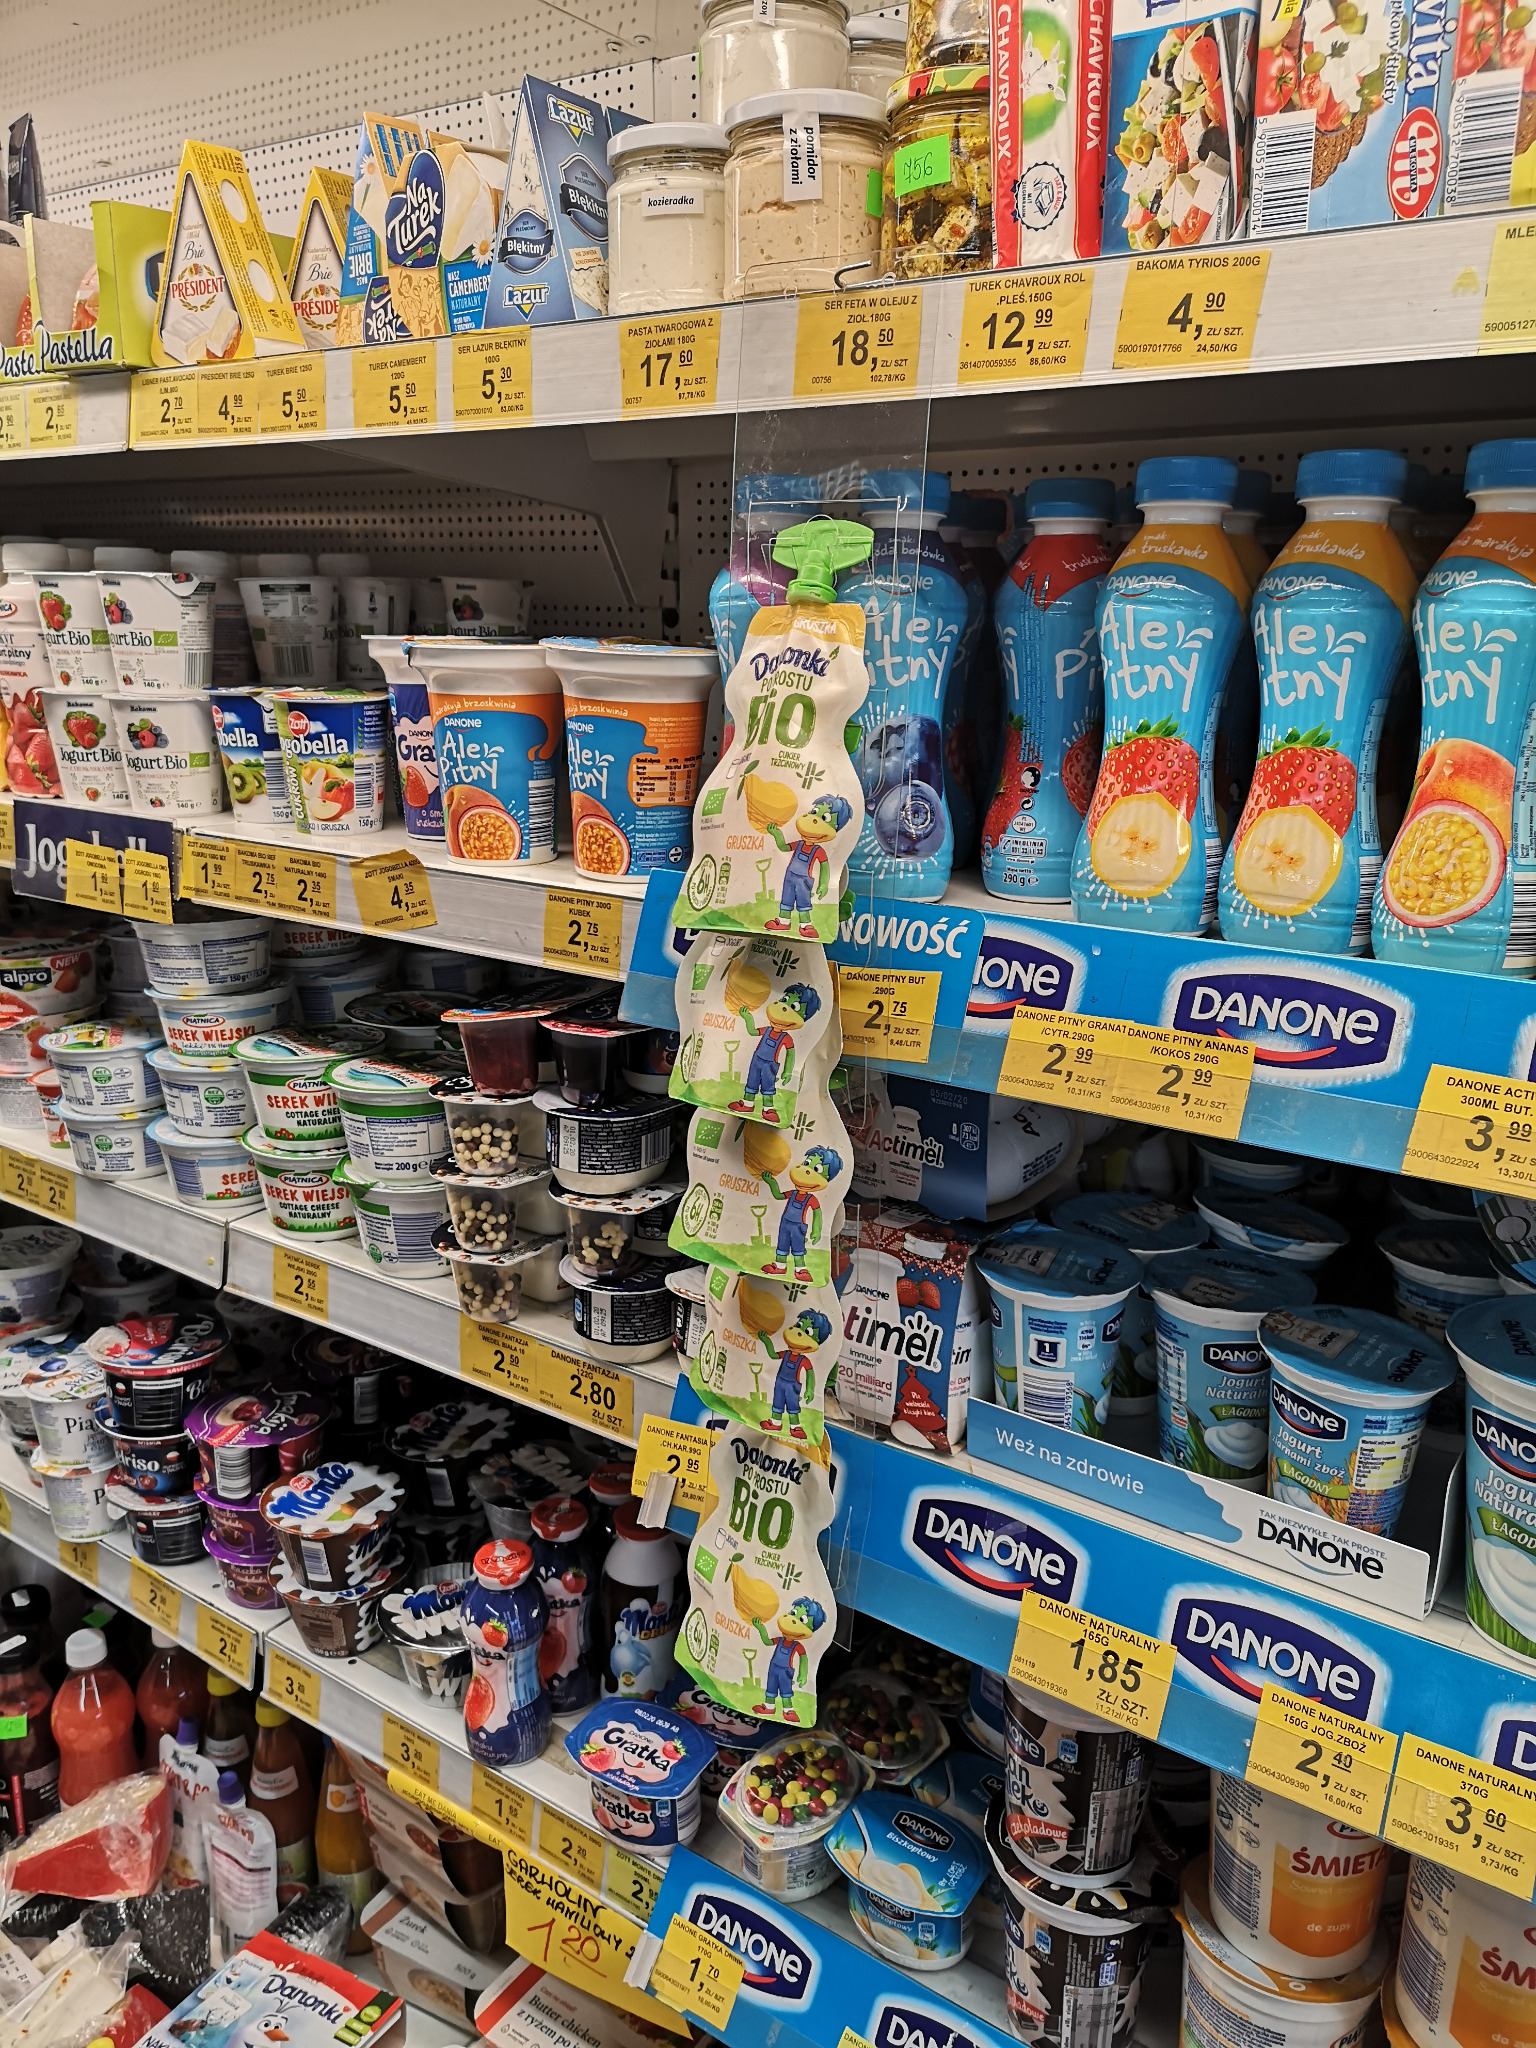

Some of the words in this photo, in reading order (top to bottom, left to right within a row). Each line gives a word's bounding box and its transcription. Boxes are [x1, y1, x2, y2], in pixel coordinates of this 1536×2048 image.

[997, 4, 1012, 161] CHAVROUX
[548, 94, 594, 136] Lazur
[790, 127, 797, 135] z
[790, 137, 802, 186] ziołami
[804, 126, 817, 181] pomidor
[407, 178, 429, 208] Na
[648, 196, 694, 207] kozieradka
[388, 186, 441, 254] Turek
[183, 241, 205, 261] Brie
[507, 239, 545, 256] Błękitny
[307, 263, 333, 281] Brie
[1136, 258, 1184, 271] BAKOMA
[1187, 257, 1228, 269] TYRIOS
[1231, 255, 1261, 267] 200G
[171, 277, 224, 299] PRÉSIDENT
[969, 282, 1002, 292] TUREK
[1004, 277, 1061, 289] CHAVROUX
[1064, 272, 1086, 284] ROL
[504, 285, 550, 308] Lazur
[824, 299, 842, 310] SER
[843, 298, 866, 309] FETA
[868, 298, 878, 307] W
[880, 296, 909, 307] OLEJU
[910, 295, 917, 304] Z
[1205, 292, 1226, 308] 90
[847, 311, 891, 323] ZIOŁ.180G
[1035, 308, 1052, 324] 99
[628, 324, 652, 338] PASTA
[653, 319, 706, 336] TWAROGOWA
[708, 318, 714, 327] Z
[878, 328, 894, 343] 50
[1224, 326, 1244, 336] SZT.
[35, 319, 114, 373] Pastella
[458, 345, 471, 355] SER
[472, 342, 491, 353] LAZUR
[492, 339, 527, 352] BŁĘKITNY
[645, 336, 675, 349] ZIOŁAMI
[677, 335, 695, 345] 180G
[1052, 339, 1071, 349] SZT.
[1118, 342, 1182, 353] 5900197017766
[1197, 342, 1237, 352] 24,50/KG
[369, 362, 388, 372] TUREK
[389, 356, 427, 370] CAMEMBERT
[484, 356, 500, 364] 100G
[679, 350, 693, 364] 60
[959, 358, 1017, 370] 3614070059355
[1029, 355, 1066, 366] 86,60/KG
[267, 369, 284, 377] TUREK
[285, 367, 297, 375] BRIE
[500, 367, 512, 379] 30
[1142, 541, 1208, 561] truskawka
[1294, 539, 1366, 561] truskawka
[1106, 575, 1177, 590] DANONE
[1258, 574, 1327, 592] DANONE
[444, 717, 482, 728] DANONE
[101, 748, 122, 762] Bio
[165, 755, 187, 769] Bio
[439, 756, 499, 790] Pitny
[726, 835, 764, 852] GRUSZKA
[549, 895, 575, 904] DANONE
[577, 898, 594, 907] PITNY
[569, 908, 591, 917] KUBEK
[587, 922, 598, 933] 75
[836, 912, 968, 959] NOWOŚĆ
[55, 952, 80, 969] NEW
[3, 970, 48, 986] alpro
[846, 973, 880, 982] DANONE
[882, 975, 907, 983] PITNY
[908, 976, 925, 984] BUT
[892, 1001, 907, 1013] 75
[1190, 986, 1380, 1045] DANONE
[1016, 1009, 1056, 1024] DANONE
[1058, 1016, 1085, 1028] PITNY
[1087, 1021, 1127, 1034] GRANAT
[1041, 1027, 1095, 1043] /CYTR.290G
[1128, 1028, 1170, 1044] DANONE
[1173, 1035, 1202, 1048] PITNY
[1205, 1040, 1249, 1055] ANANAS
[1076, 1047, 1093, 1061] 99
[1150, 1046, 1191, 1062] /KOKOS
[1194, 1052, 1219, 1065] 290G
[1193, 1068, 1212, 1084] 99
[1000, 1075, 1054, 1091] 5900643039632
[1067, 1087, 1102, 1099] 10,31/KG
[285, 1110, 321, 1120] COTTAGE
[1111, 1095, 1170, 1113] 5900643039618
[1184, 1109, 1223, 1124] 10,31/KG
[1460, 1095, 1500, 1112] 300ML
[1504, 1103, 1533, 1117] BUT.
[1508, 1121, 1532, 1138] 99
[719, 1173, 760, 1196] GRUSZKA
[279, 1201, 314, 1212] COTTAGE
[314, 1201, 340, 1211] CHEESE
[288, 1210, 331, 1219] NATURALNY
[478, 1324, 500, 1337] DANONE
[551, 1350, 581, 1368] DANONE
[582, 1361, 620, 1382] FANTAZJA
[576, 1368, 593, 1380] 122G
[570, 1374, 615, 1410] 2,80
[1220, 1376, 1266, 1389] Jogurt
[1273, 1386, 1339, 1432] DANONE
[647, 1425, 674, 1437] DANONE
[676, 1432, 708, 1445] FANTASIA
[1276, 1426, 1322, 1459] Jogurt
[996, 1427, 1036, 1455] Weź
[1039, 1443, 1062, 1465] na
[1066, 1456, 1144, 1495] zdrowie
[1315, 1462, 1346, 1479] zbóż
[1284, 1463, 1333, 1495] ŁAGODNY
[1260, 1509, 1276, 1520] TAK
[1278, 1516, 1329, 1539] NIEZWYKŁE.
[1331, 1535, 1349, 1546] TAK
[1351, 1542, 1387, 1560] PROSTE.
[924, 1506, 1066, 1586] DANONE
[1258, 1518, 1383, 1579] DANONE
[714, 1611, 751, 1640] GRUSZKA
[1038, 1597, 1087, 1626] DANONE
[1089, 1616, 1160, 1654] NATURALNY
[1082, 1628, 1110, 1648] 165G
[1186, 1607, 1361, 1701] DANONE
[1068, 1637, 1144, 1694] 1,85
[1011, 1666, 1068, 1696] 5900643019368
[1120, 1697, 1149, 1720] SZT.
[1271, 1692, 1317, 1719] DANONE
[1318, 1712, 1385, 1745] NATURALNY
[1283, 1712, 1309, 1730] 150G
[602, 1727, 670, 1772] Gratka
[1331, 1751, 1353, 1768] 40
[1416, 1747, 1465, 1774] DANONE
[1467, 1766, 1536, 1802] NATURALNY
[1460, 1780, 1489, 1799] 370G
[592, 1788, 649, 1824] Gratka
[1324, 1793, 1363, 1815] 16,00/KG
[1485, 1809, 1507, 1828] 60
[899, 1818, 949, 1847] DANONE
[887, 1831, 938, 1863] Biszkoptowy
[1480, 1856, 1520, 1878] 9,73/KG
[672, 1917, 698, 1938] DANONE
[698, 1932, 722, 1954] GRATKA
[697, 1901, 802, 1983] DANONE
[524, 2013, 555, 2039] ryżem
[554, 2035, 571, 2047] po
[528, 1995, 562, 2022] Butter
[560, 2016, 602, 2048] chicken
